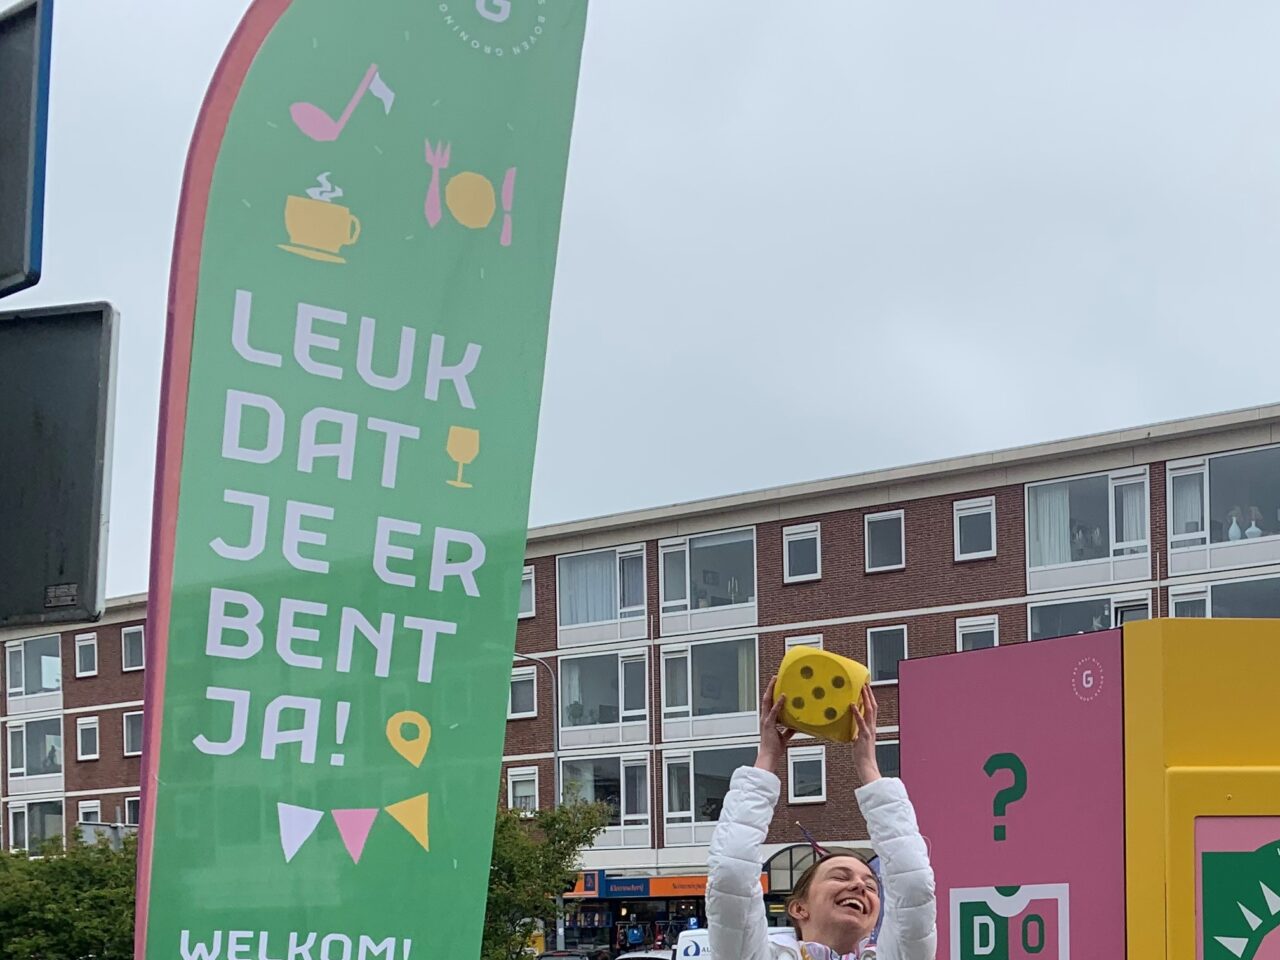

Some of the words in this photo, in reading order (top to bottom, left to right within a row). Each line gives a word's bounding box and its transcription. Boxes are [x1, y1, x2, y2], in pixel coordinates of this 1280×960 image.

[231, 289, 482, 409] LEUK
[221, 389, 421, 489] DAT
[208, 488, 335, 574] JE
[372, 516, 487, 598] ER
[205, 587, 458, 684] BENT
[1082, 669, 1094, 688] G
[192, 686, 351, 767] JA!
